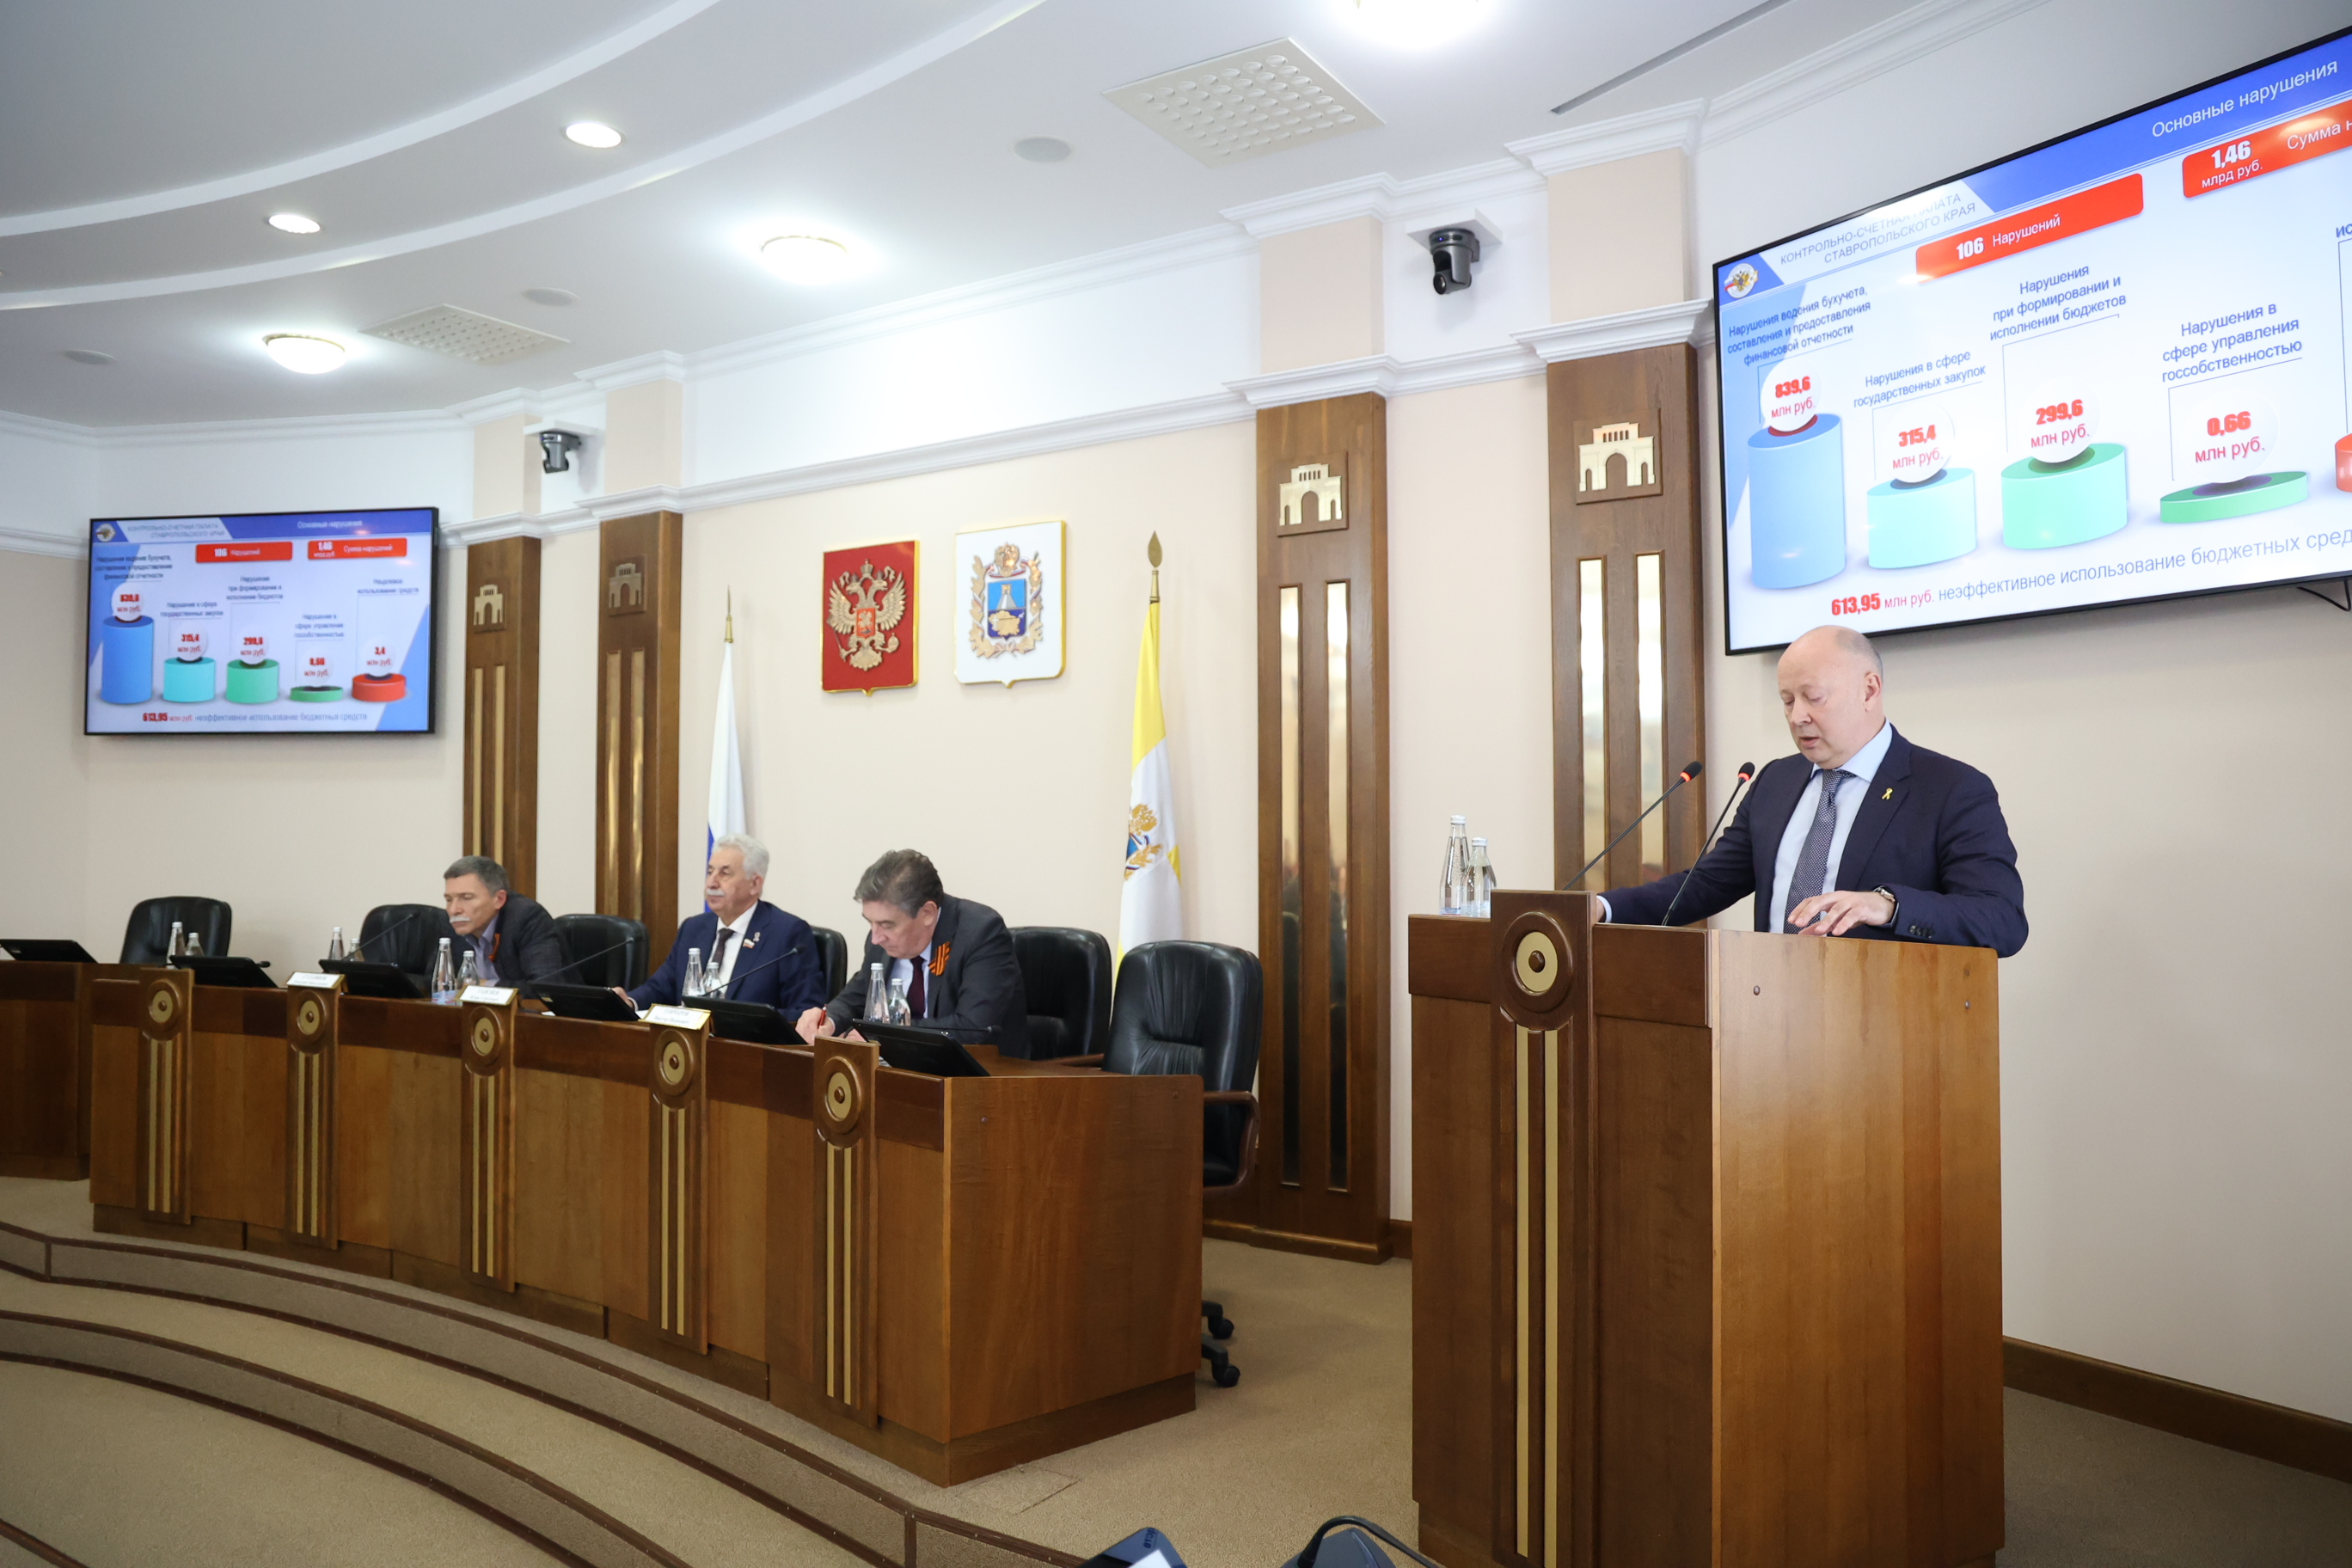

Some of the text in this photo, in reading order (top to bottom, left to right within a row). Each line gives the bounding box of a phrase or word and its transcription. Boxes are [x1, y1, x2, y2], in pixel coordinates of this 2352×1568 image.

[2151, 59, 2338, 138] Основные нарушения
[2211, 140, 2252, 170] 1,46
[2287, 123, 2342, 150] Сумма
[2202, 159, 2263, 188] млрд руб.
[1824, 202, 1975, 264] СТАВРОПОЛЬСКОГО КРАЯ
[1956, 213, 2061, 260] 106 Нарушений
[1993, 275, 2122, 322] при формировании и
[2019, 265, 2090, 295] Нарушения
[1727, 302, 1871, 354] составления и предоставления
[1728, 285, 1868, 338] Нарушения ведения бухучета,
[1989, 293, 2127, 340] исполнении бюджетов
[2181, 303, 2277, 338] Нарушения в
[1743, 324, 1854, 367] финансовой отчетности
[2162, 318, 2300, 364] сфере управления
[1865, 348, 1971, 389] Нарушения в сфере
[2161, 339, 2303, 383] госсобственностью
[1774, 376, 1811, 399] 839,6
[1853, 364, 1986, 407] государственных закупок
[1771, 397, 1816, 420] млн руб.
[2035, 398, 2084, 426] 299,6
[2207, 411, 2251, 437] 0,66
[1898, 425, 1936, 448] 315,4
[2030, 424, 2091, 449] млн руб.
[2195, 436, 2265, 463] млн руб.
[1892, 449, 1944, 470] млн руб.
[1831, 592, 1881, 616] 613,95
[1884, 595, 1908, 609] млн
[1910, 589, 1935, 609] руб.
[1939, 572, 2055, 603] неэффективное
[2061, 554, 2186, 585] использование
[2191, 536, 2300, 566] бюджетных
